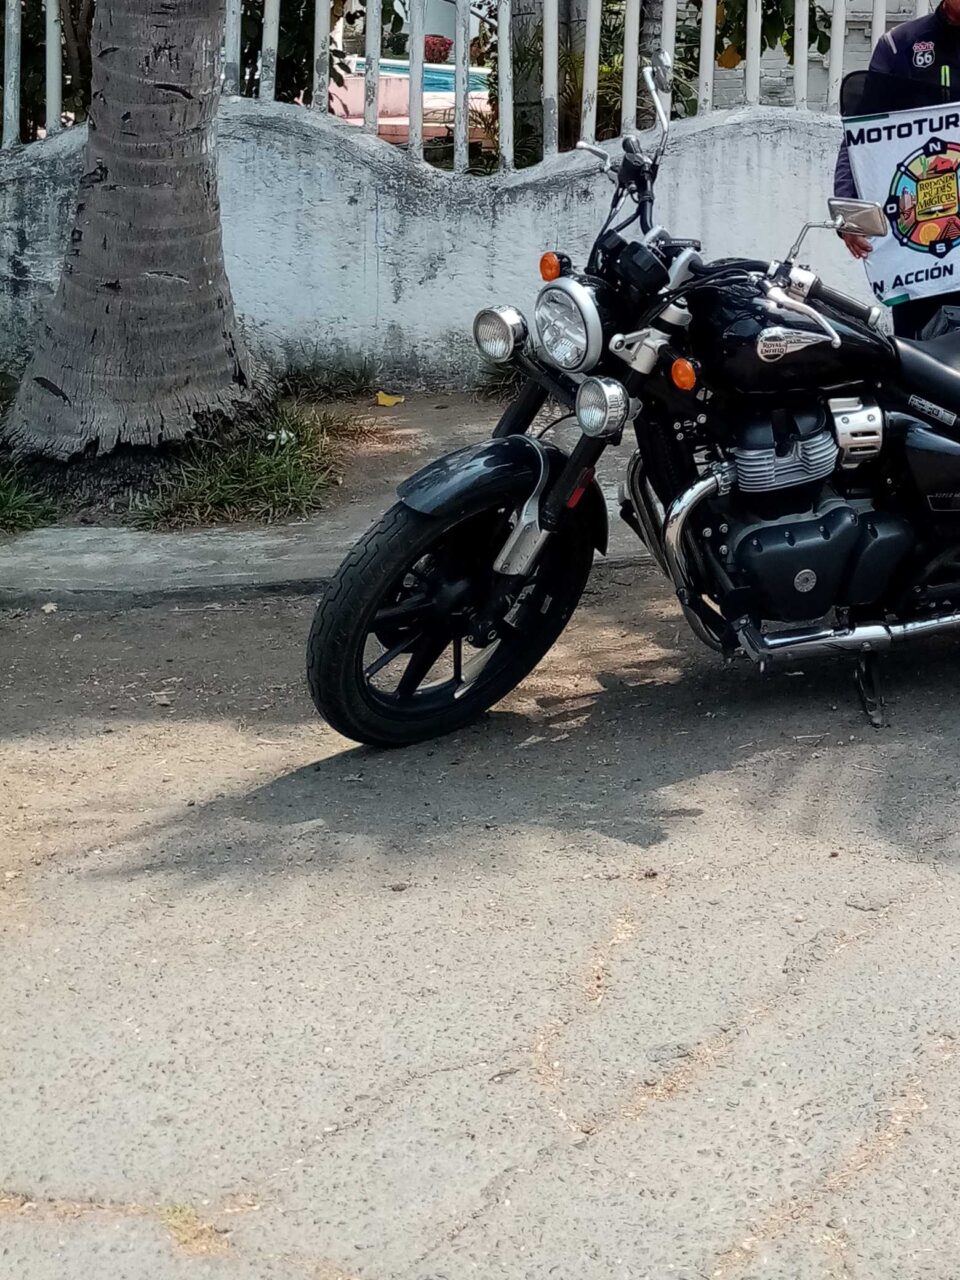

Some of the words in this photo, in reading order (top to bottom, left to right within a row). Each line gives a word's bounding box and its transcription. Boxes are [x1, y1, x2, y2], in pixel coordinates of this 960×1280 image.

[916, 51, 933, 66] 66
[929, 141, 942, 152] N
[886, 203, 897, 214] O
[936, 244, 946, 253] S
[870, 279, 885, 296] N
[891, 262, 954, 290] ACCIÓN
